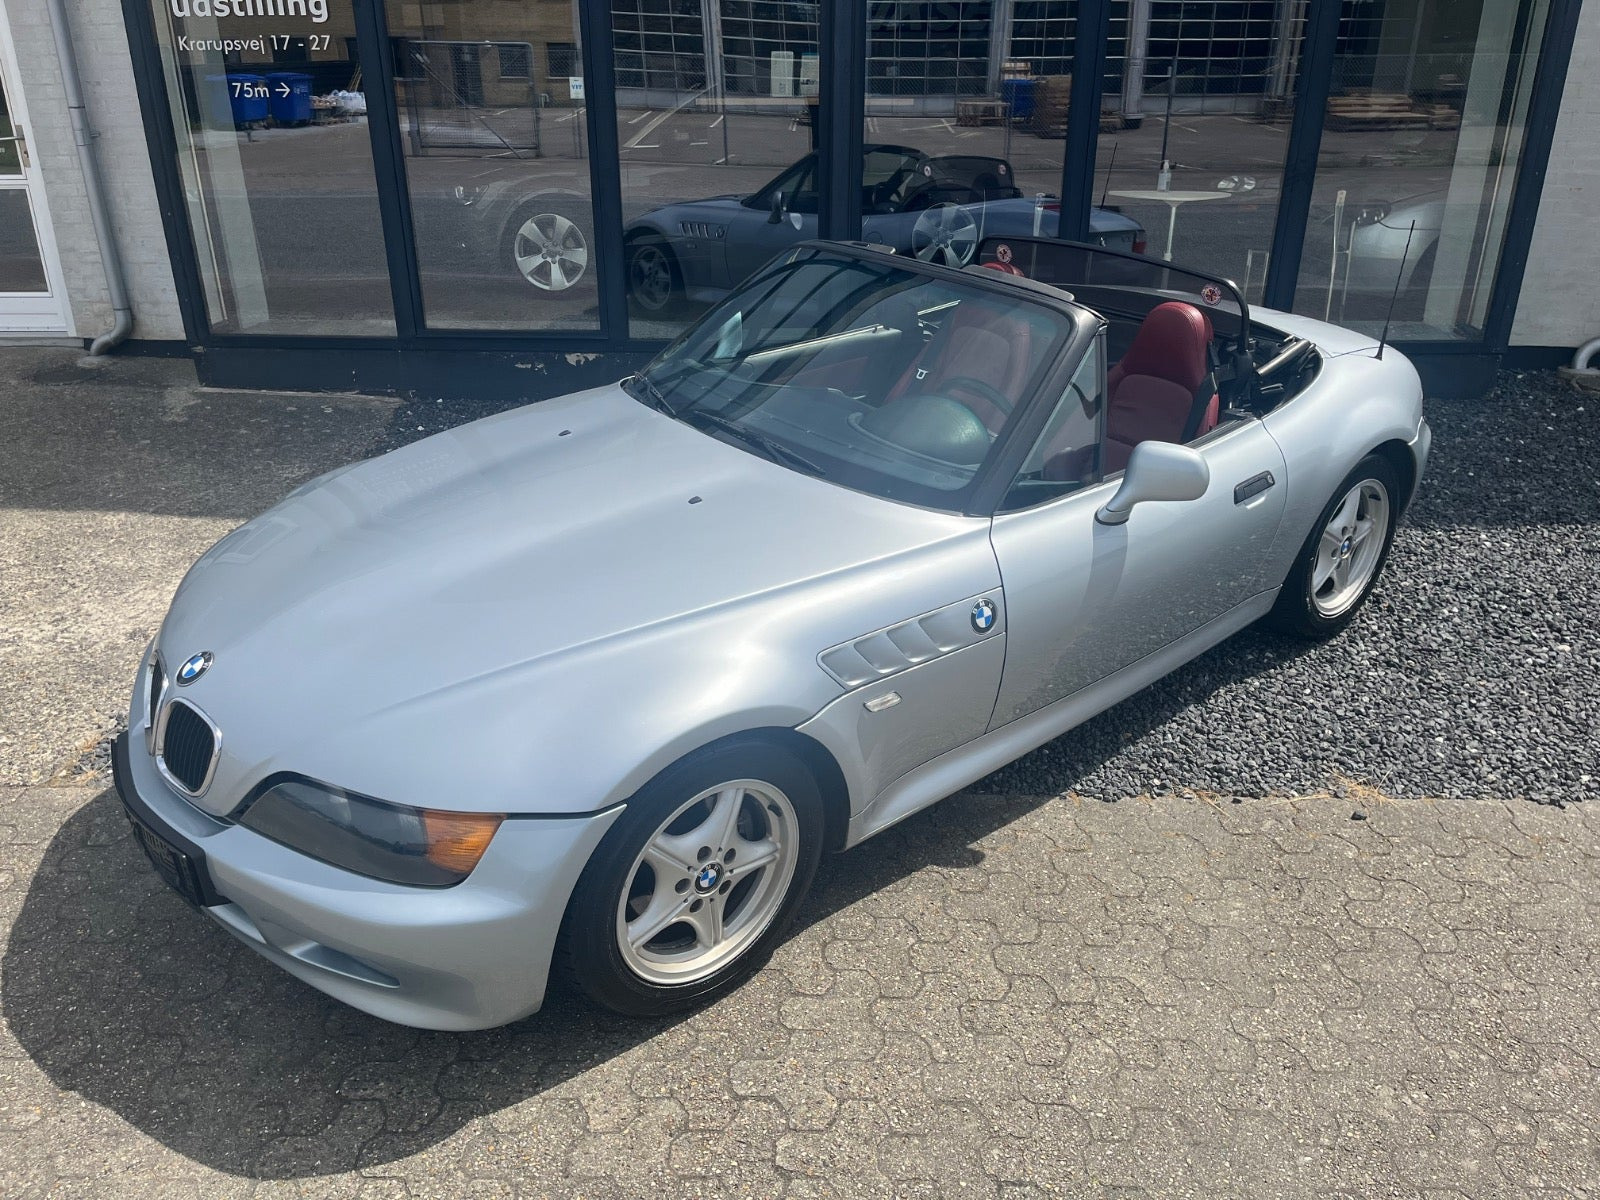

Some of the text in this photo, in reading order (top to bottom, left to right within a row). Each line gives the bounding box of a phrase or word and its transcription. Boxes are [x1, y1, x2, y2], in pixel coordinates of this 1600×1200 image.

[178, 35, 265, 55] Krarupsvej
[271, 35, 290, 51] 17
[309, 35, 331, 51] 27
[232, 83, 270, 98] 75m
